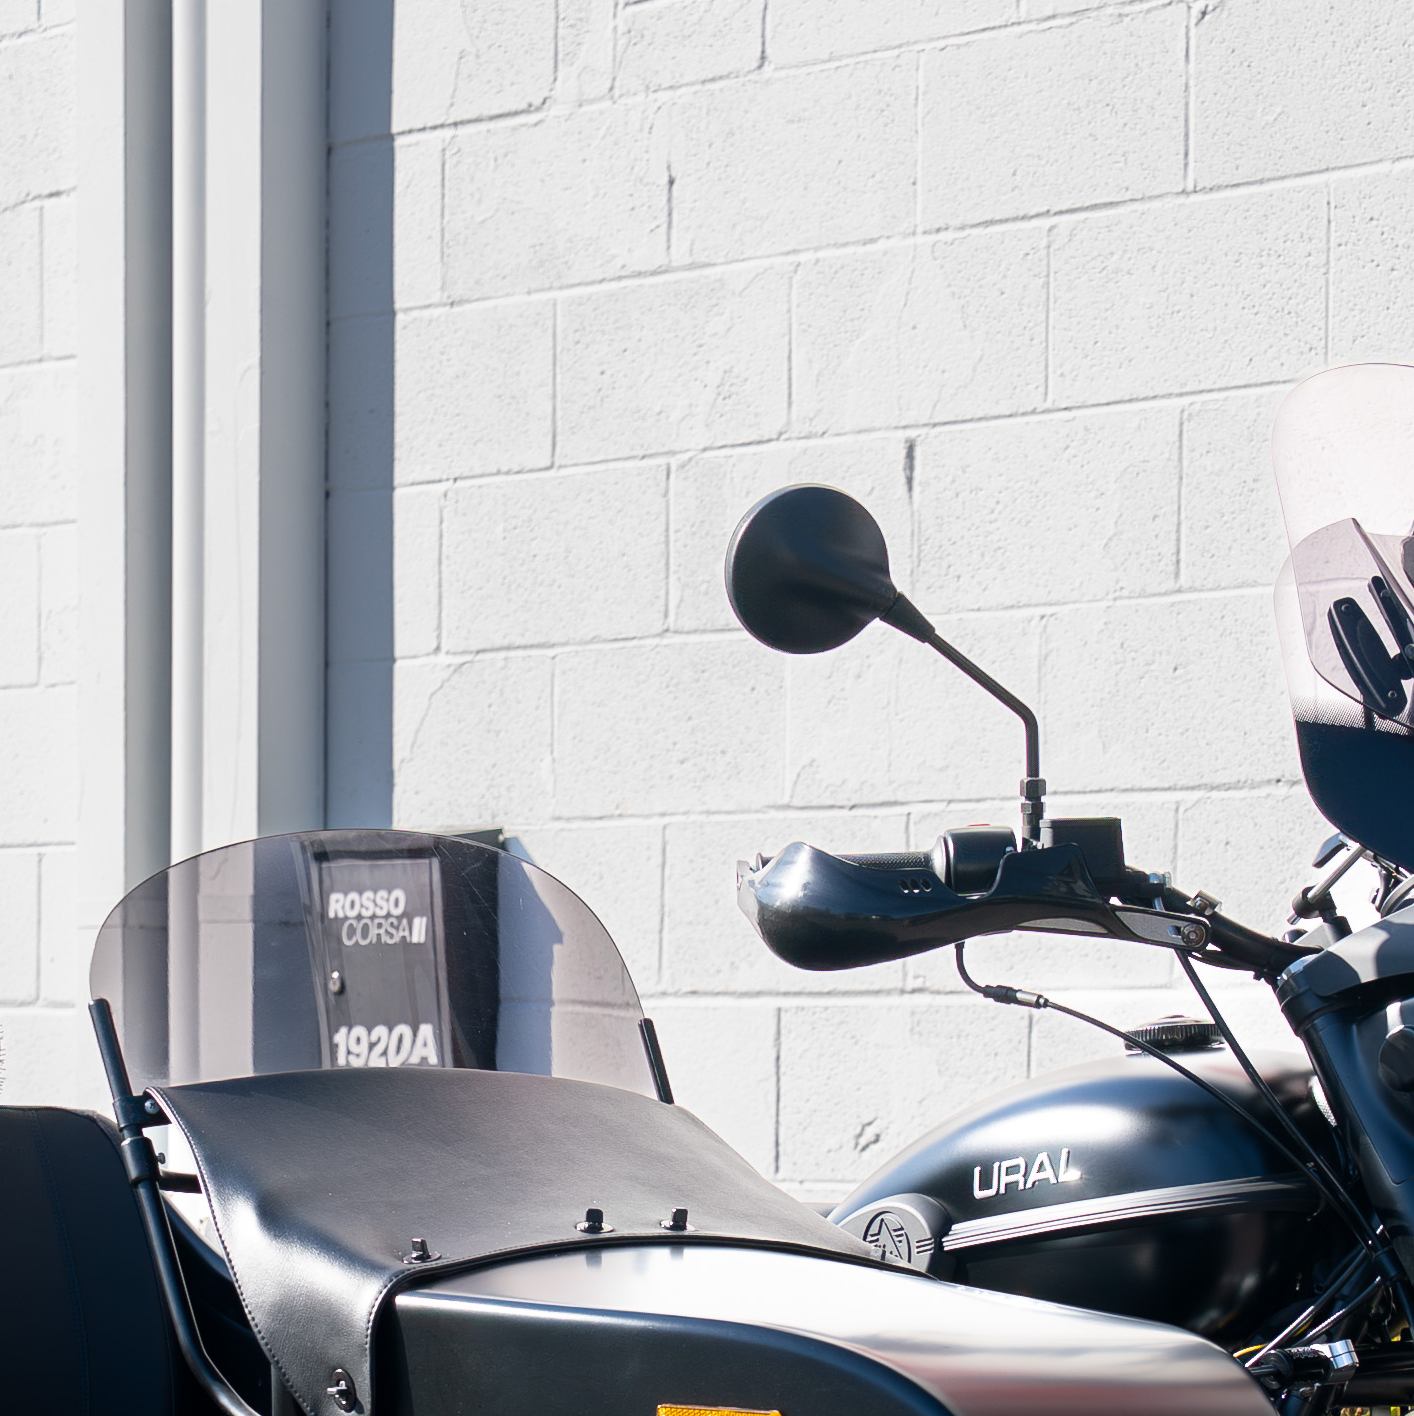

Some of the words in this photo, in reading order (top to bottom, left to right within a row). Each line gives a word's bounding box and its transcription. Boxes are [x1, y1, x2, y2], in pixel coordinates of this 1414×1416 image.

[329, 889, 406, 918] ROSSO
[334, 1024, 438, 1067] 1920A
[974, 1148, 1082, 1200] URAL
